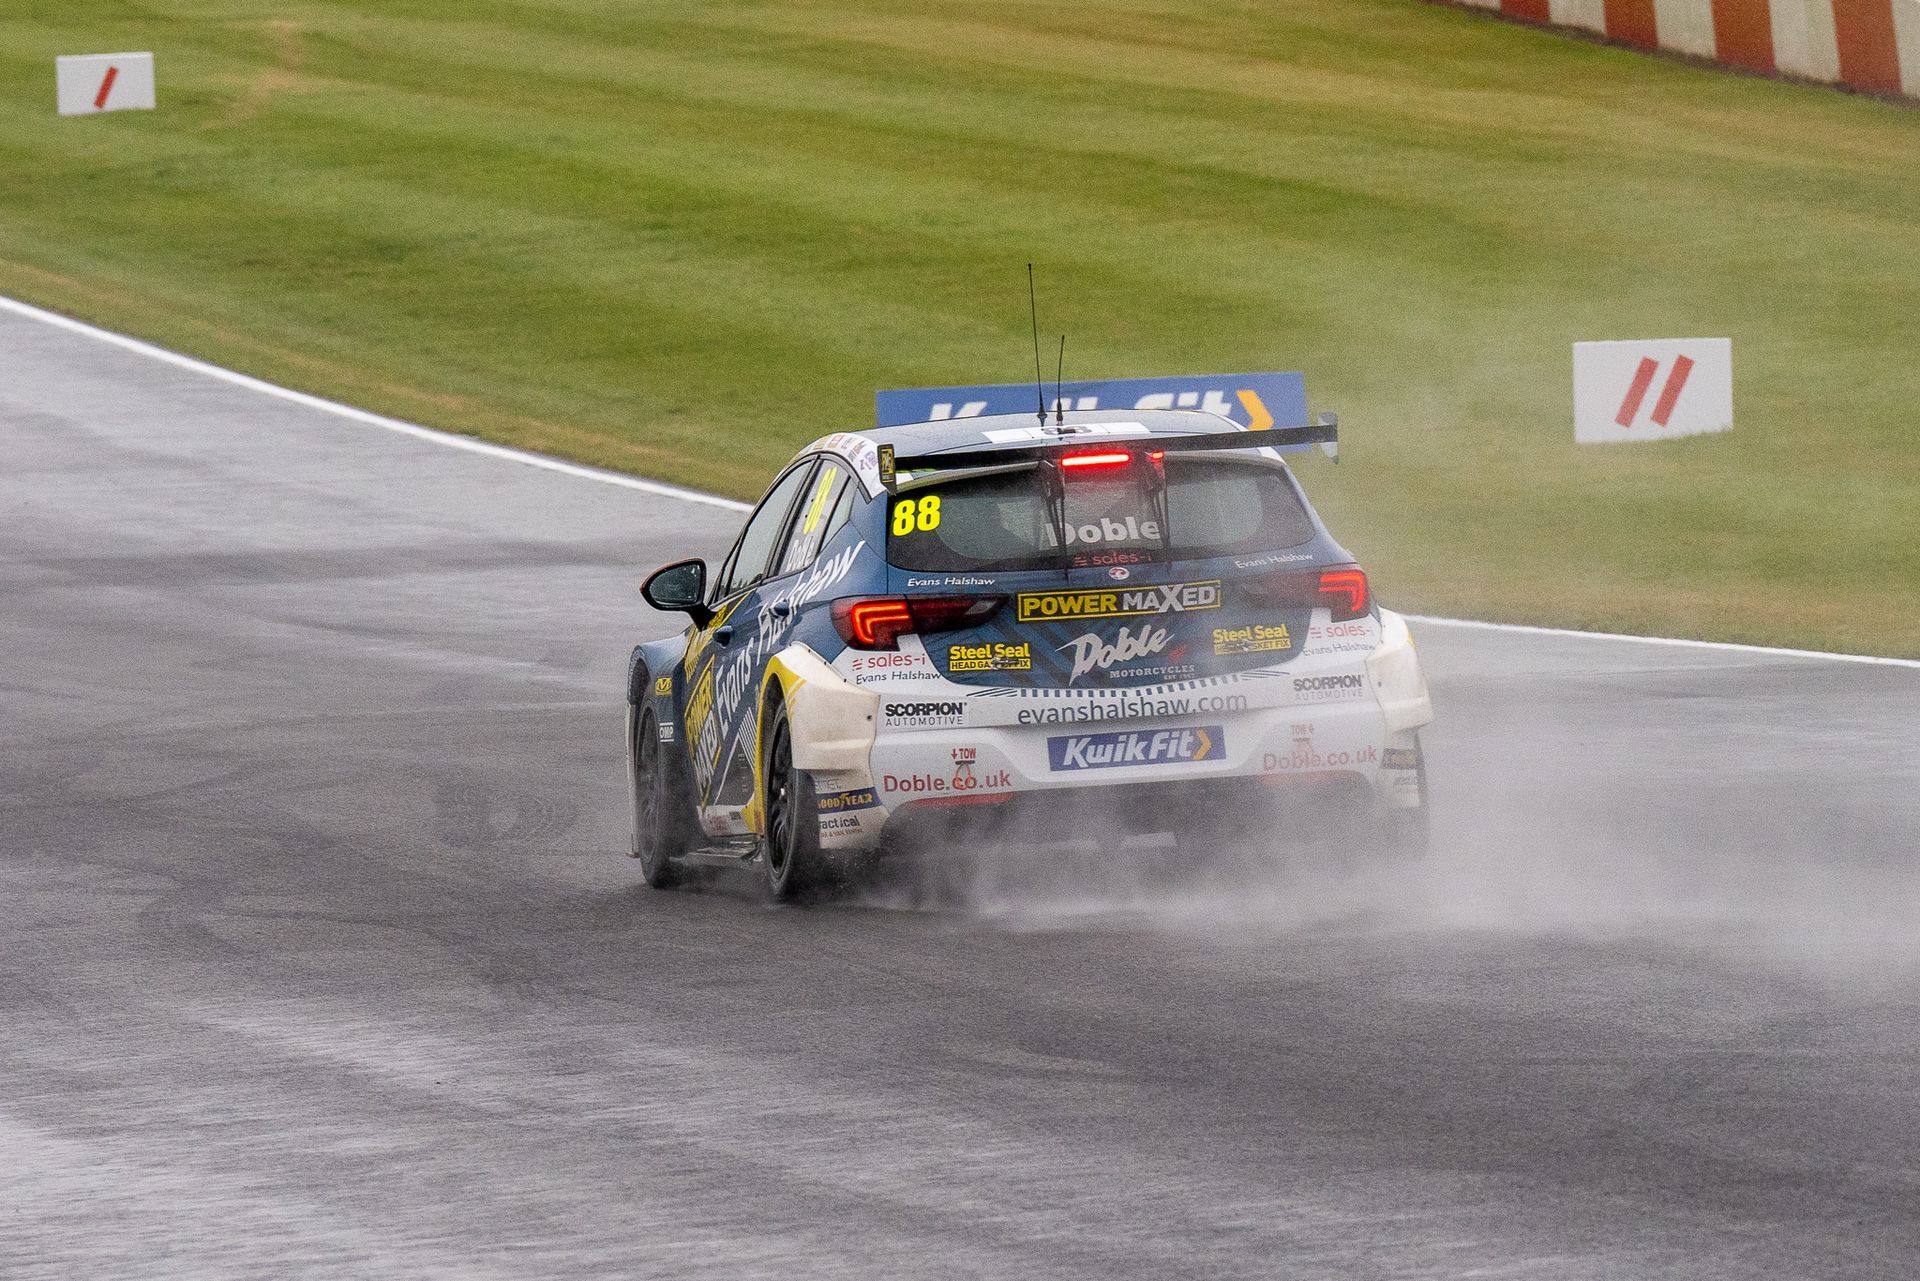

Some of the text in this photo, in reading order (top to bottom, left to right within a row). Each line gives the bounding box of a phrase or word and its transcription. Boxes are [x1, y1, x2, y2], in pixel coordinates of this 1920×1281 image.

[893, 495, 941, 536] 88
[1046, 516, 1161, 546] Doble
[1235, 554, 1314, 569] Evans Halshaw
[907, 576, 996, 588] Evans Halshaw
[1023, 594, 1118, 616] POWER
[1213, 623, 1290, 643] Steel Seal
[949, 643, 1030, 660] Steel Seal
[1332, 641, 1376, 652] Halshaw
[868, 653, 926, 668] sales-i
[1055, 624, 1175, 687] Doble
[951, 661, 976, 670] HEAD
[1109, 665, 1196, 679] MOTORCYCLES
[856, 671, 942, 685] Evans Halshaw
[1293, 675, 1362, 691] SCORPION
[715, 637, 755, 741] Evans
[1295, 688, 1364, 701] AUTOMOTIVE
[885, 702, 963, 717] SCORPION
[1018, 694, 1248, 725] evanshalshaw.com
[885, 716, 964, 727] AUTOMOTIVE
[659, 726, 674, 738] OMP
[959, 748, 977, 759] TOW
[1263, 745, 1378, 771] Doble.co.uk
[883, 770, 1012, 793] Doble.co.uk
[819, 816, 861, 830] actical
